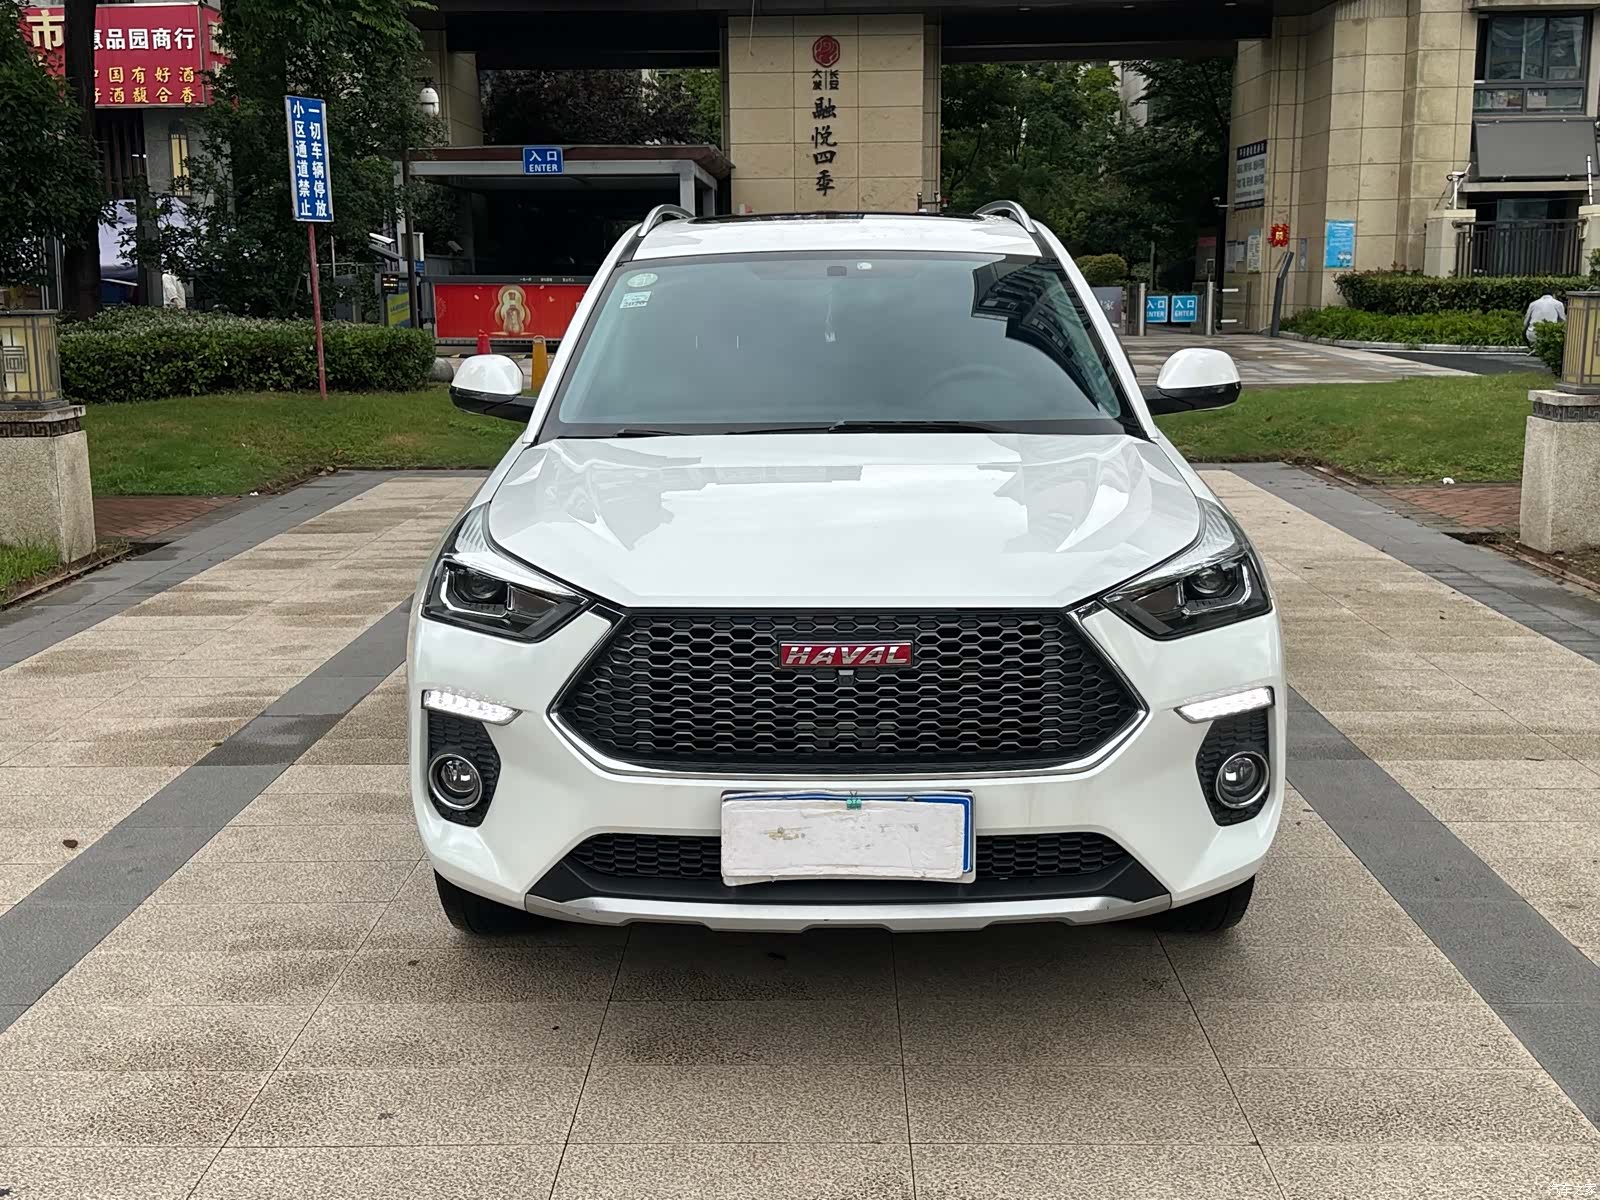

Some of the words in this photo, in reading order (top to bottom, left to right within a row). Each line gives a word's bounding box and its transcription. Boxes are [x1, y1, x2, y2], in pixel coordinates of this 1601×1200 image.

[26, 9, 65, 50] 市
[529, 150, 558, 162] 入口
[811, 97, 838, 196] 融悦四季
[293, 100, 312, 217] 小区通道禁止
[308, 108, 328, 217] 一切车辆停放
[529, 163, 558, 172] ENTER
[1146, 300, 1165, 309] 入口
[1175, 299, 1195, 309] 入口
[785, 646, 908, 665] HAVAL
